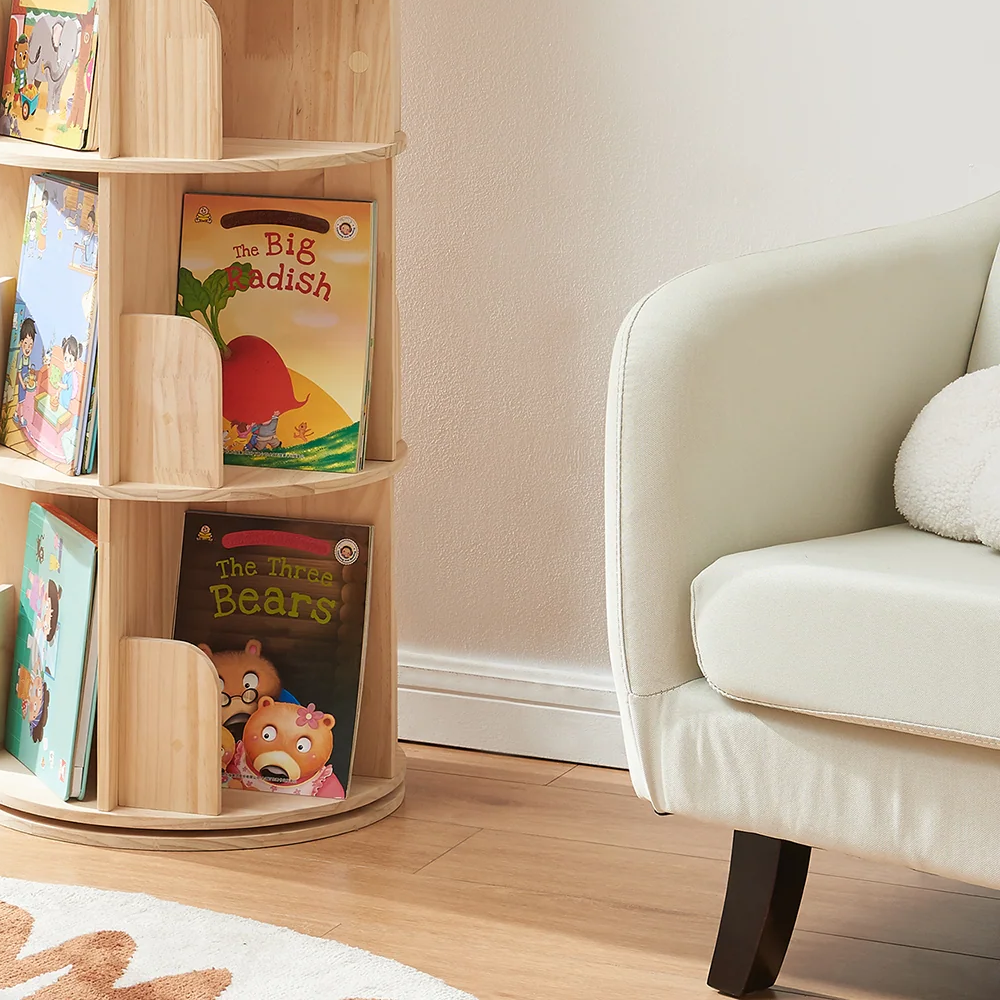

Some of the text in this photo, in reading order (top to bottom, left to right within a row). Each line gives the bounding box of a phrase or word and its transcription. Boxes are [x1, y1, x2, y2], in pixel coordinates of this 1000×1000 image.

[233, 232, 316, 266] The Big
[225, 263, 332, 302] Radish
[216, 557, 333, 587] The Three
[209, 584, 337, 625] Bears
